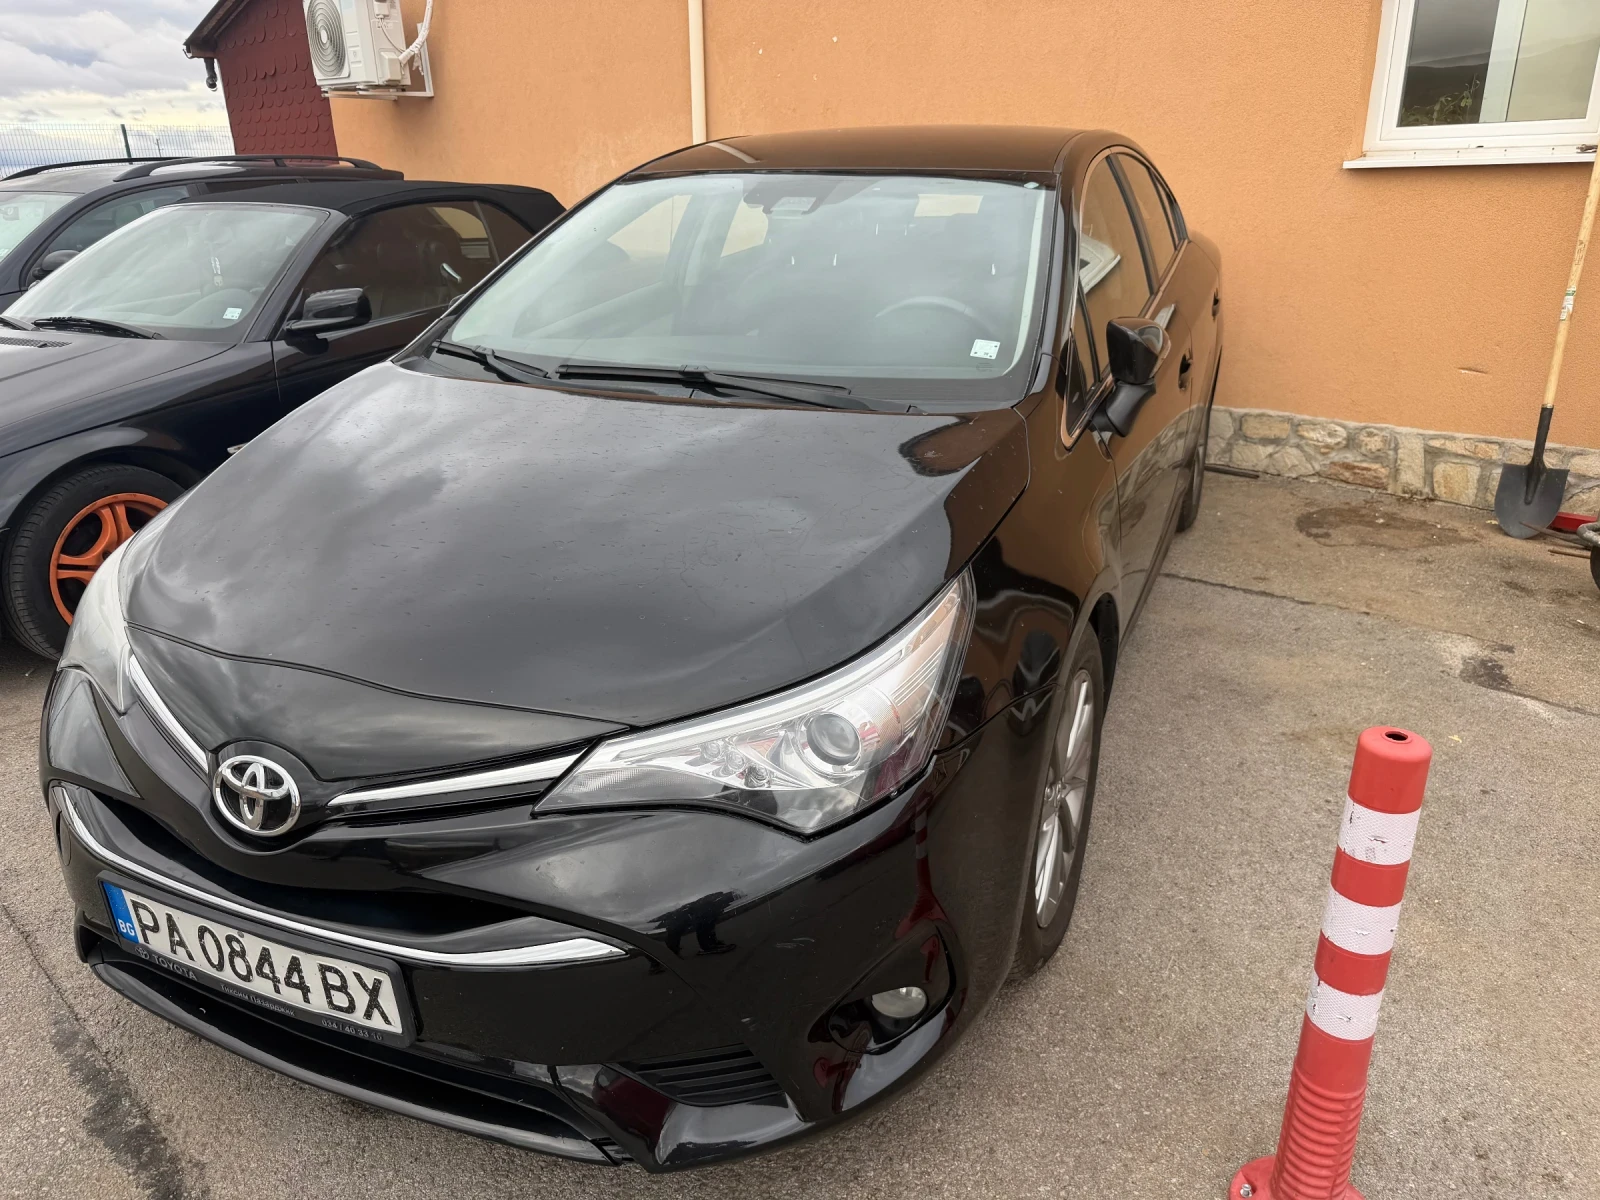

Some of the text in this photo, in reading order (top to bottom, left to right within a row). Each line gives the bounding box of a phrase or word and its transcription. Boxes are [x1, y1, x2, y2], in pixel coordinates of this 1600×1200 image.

[117, 918, 135, 937] BG
[152, 954, 198, 980] TOYOTA
[321, 1019, 338, 1029] 034
[344, 1025, 356, 1035] 40
[358, 1029, 370, 1038] 33
